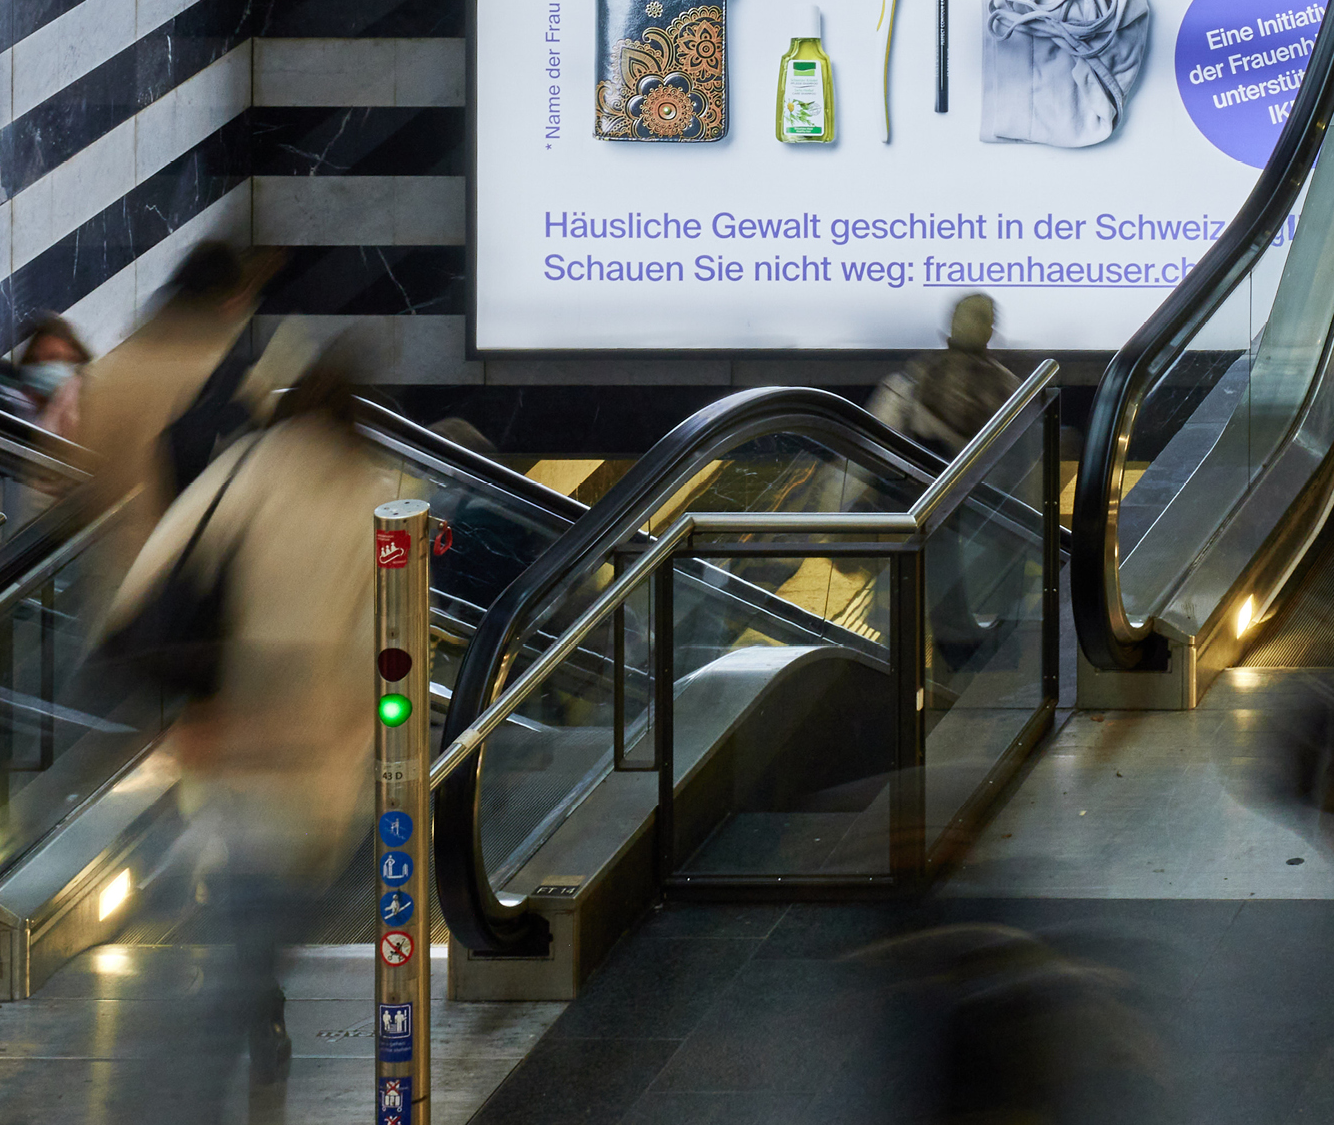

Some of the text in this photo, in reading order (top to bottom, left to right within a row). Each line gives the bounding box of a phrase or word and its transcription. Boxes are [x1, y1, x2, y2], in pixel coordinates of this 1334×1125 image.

[545, 2, 561, 43] Frau
[1205, 25, 1254, 50] Eine
[545, 49, 561, 79] der
[1189, 34, 1318, 85] der Frauenh
[545, 84, 561, 139] Name
[1268, 99, 1295, 125] IK
[545, 211, 1226, 246] Häusliche Gewalt geschieht in der Schweiz
[544, 254, 684, 282] Schauen
[694, 254, 744, 282] Sie
[754, 254, 832, 282] nicht
[841, 261, 914, 289] weg:
[395, 771, 403, 780] D
